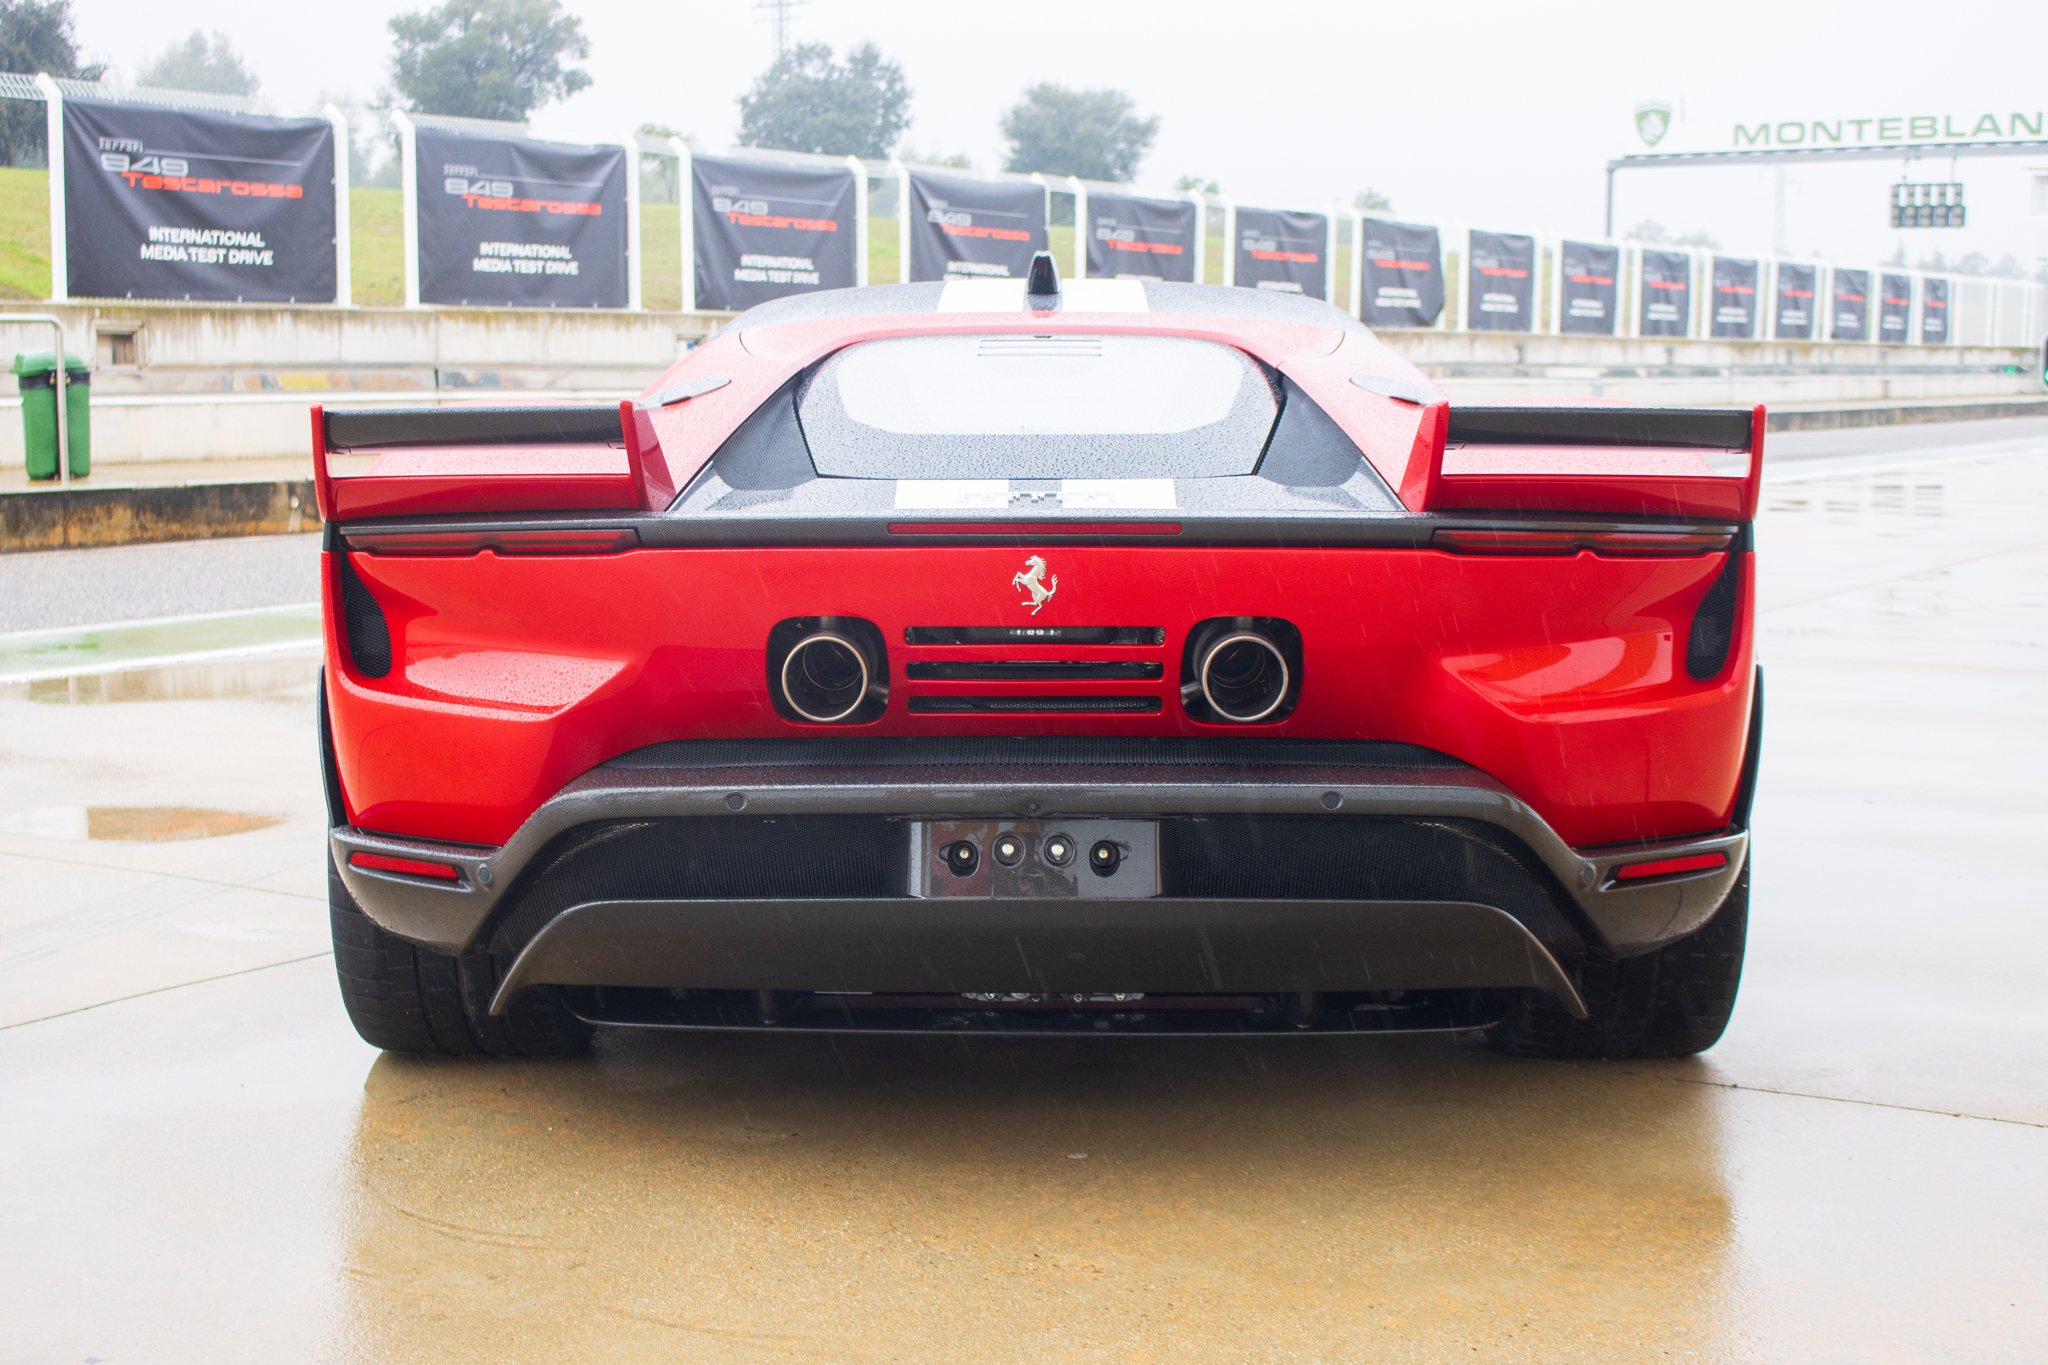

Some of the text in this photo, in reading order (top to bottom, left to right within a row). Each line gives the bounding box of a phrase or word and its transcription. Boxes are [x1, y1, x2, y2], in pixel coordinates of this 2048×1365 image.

[1734, 112, 2043, 146] MONTEBLAN
[101, 152, 189, 178] 849
[121, 172, 303, 199] Testarossa
[444, 177, 514, 198] 849
[461, 194, 602, 215] Testarossa
[149, 225, 266, 247] INTERNATIONAL
[141, 243, 274, 266] MEDIA TEST DRIVE
[480, 241, 573, 260] INTERNATIONAL
[473, 257, 580, 276] MEDIA TEST DRIVE
